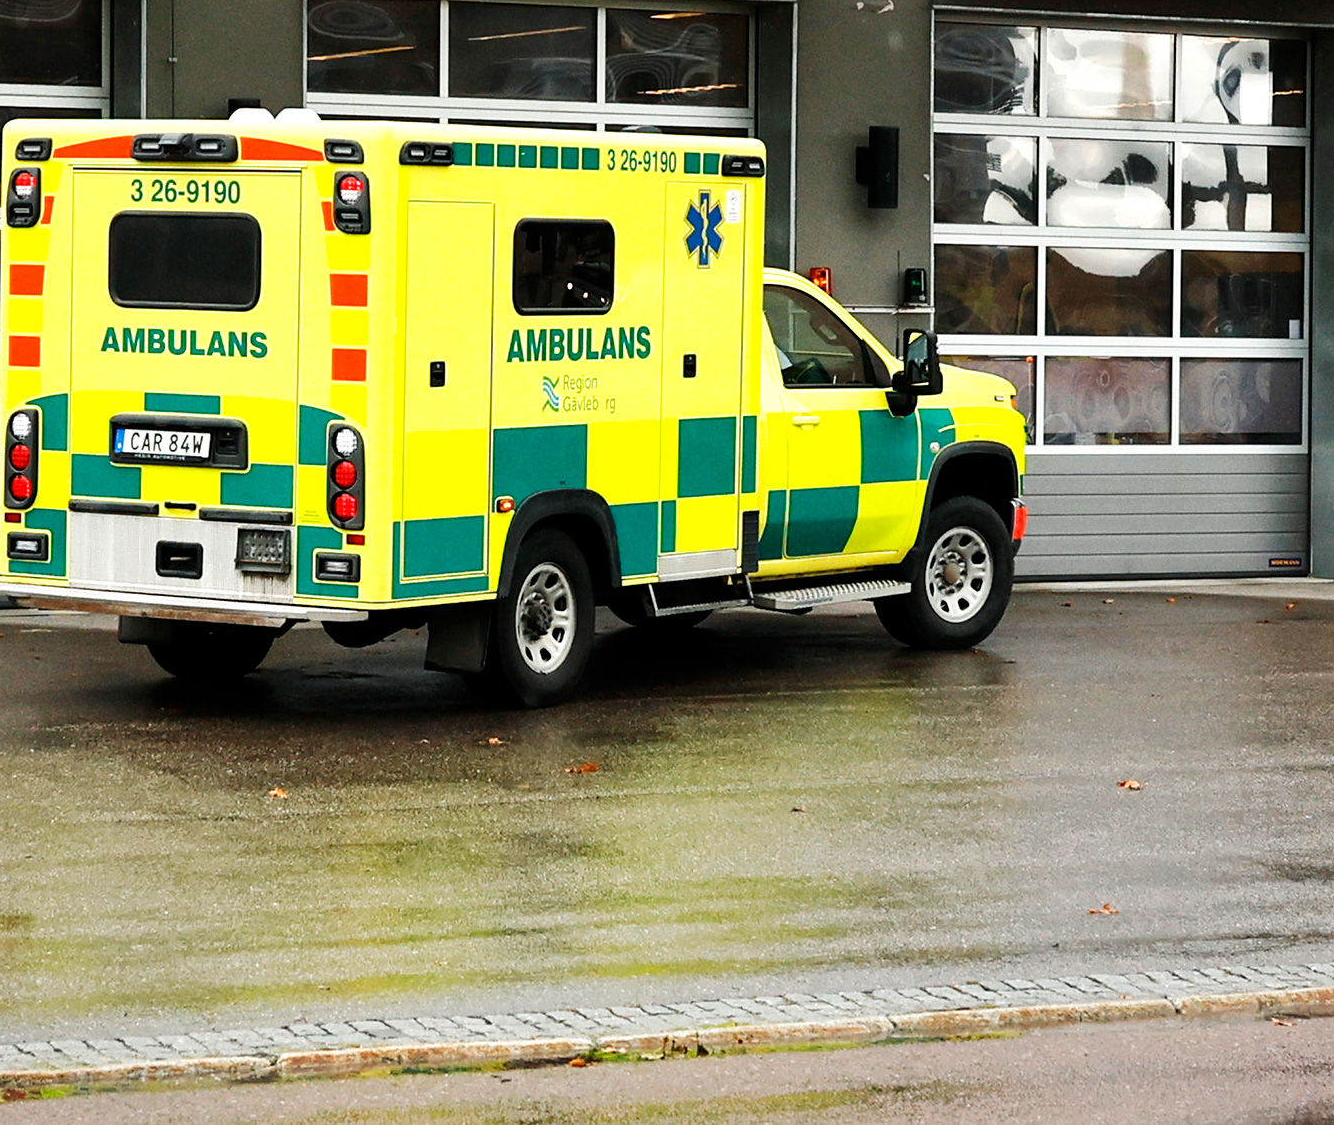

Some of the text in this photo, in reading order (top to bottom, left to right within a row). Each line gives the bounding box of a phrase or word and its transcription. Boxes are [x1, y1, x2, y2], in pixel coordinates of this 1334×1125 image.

[607, 148, 677, 173] 3 26-9190
[131, 179, 241, 204] 3 26-9190
[100, 326, 268, 359] AMBULANS
[506, 325, 651, 363] AMBULANS
[563, 374, 598, 394] Region
[562, 395, 616, 414] Gävlebrg
[131, 432, 204, 454] CAR 84W
